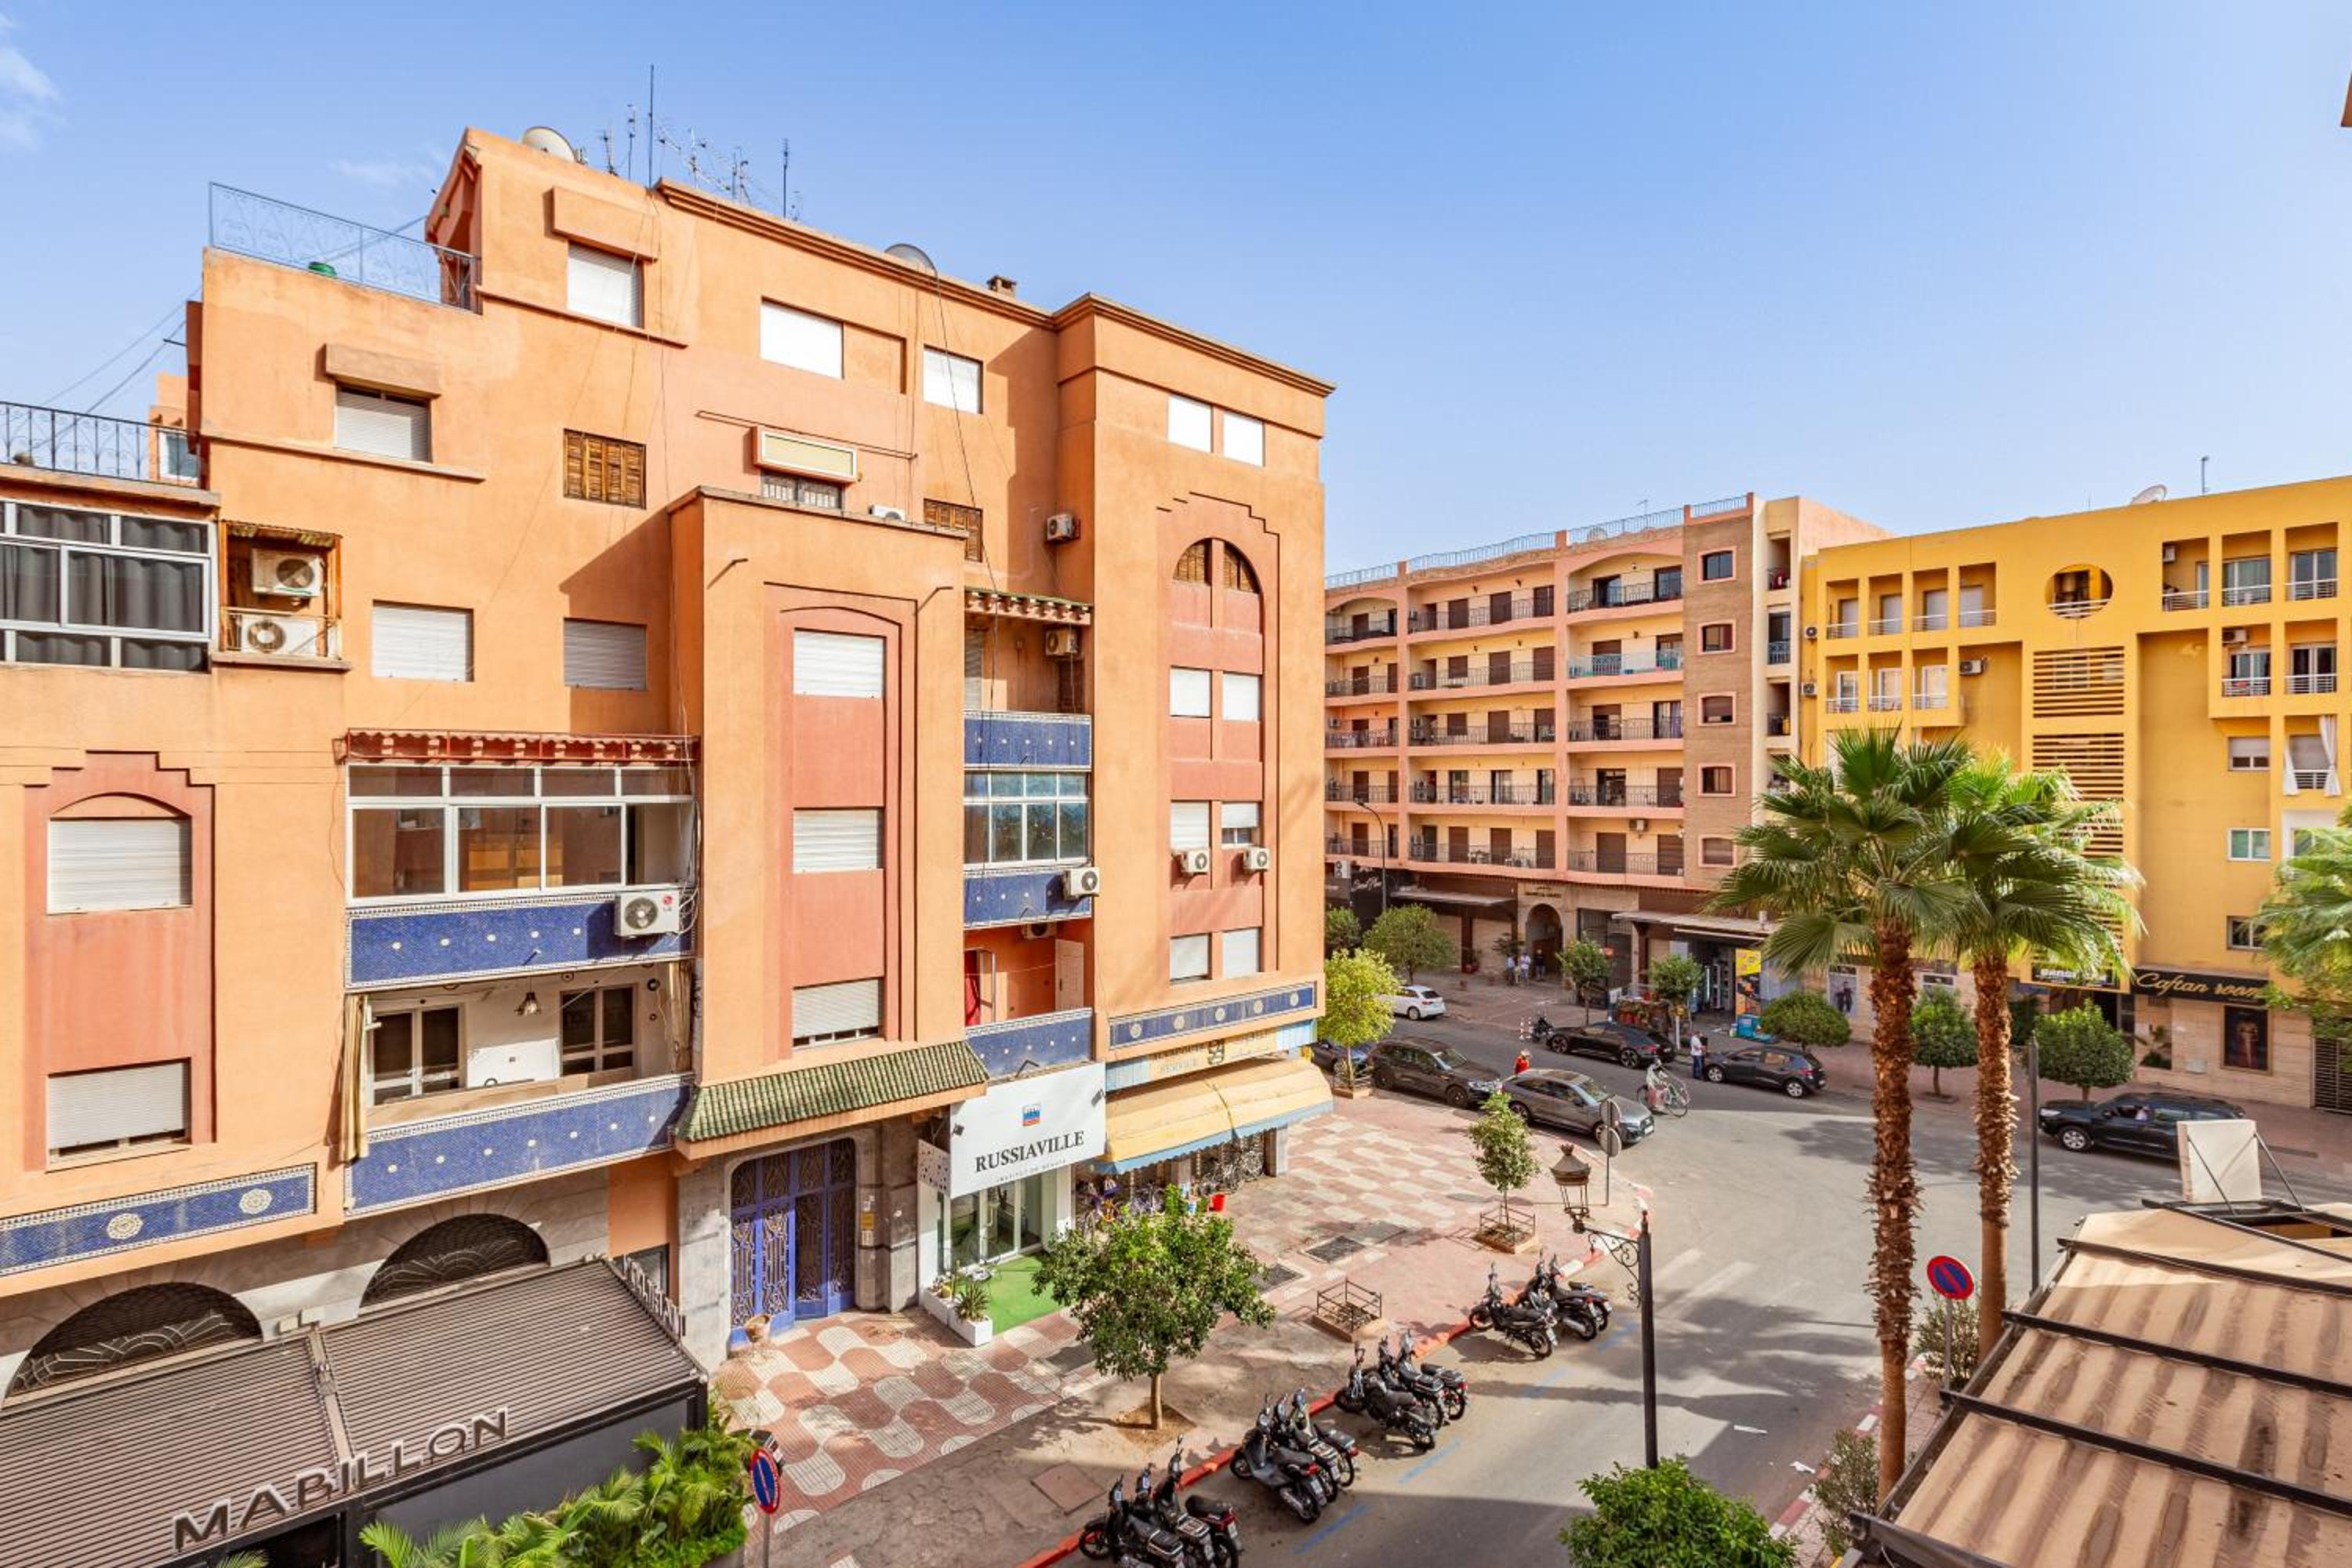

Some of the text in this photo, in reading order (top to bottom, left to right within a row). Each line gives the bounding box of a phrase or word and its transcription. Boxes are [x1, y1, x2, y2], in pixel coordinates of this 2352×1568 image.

[2136, 973, 2209, 996] Caftan
[975, 1131, 1084, 1172] RUSSIAVILLE
[173, 1407, 509, 1550] MABILLON
